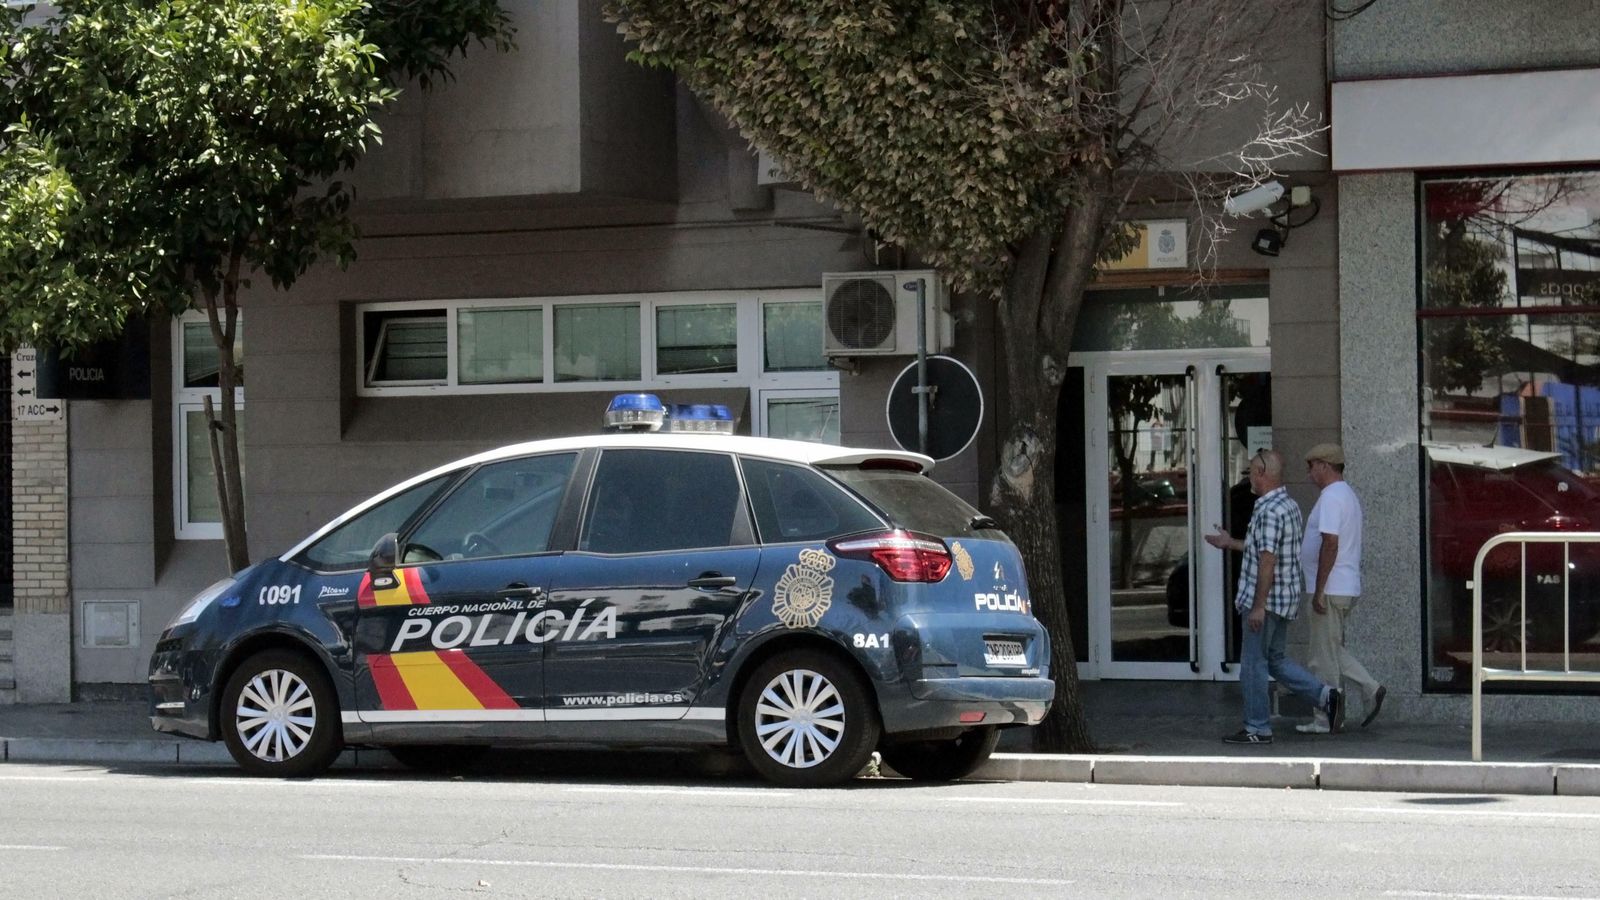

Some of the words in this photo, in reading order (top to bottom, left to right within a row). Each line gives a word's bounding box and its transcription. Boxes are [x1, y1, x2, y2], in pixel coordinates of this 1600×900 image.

[69, 367, 104, 380] POLICIA
[17, 405, 26, 416] 17
[27, 405, 45, 416] ACC
[267, 584, 302, 606] 091
[408, 605, 460, 617] CUERPO
[460, 601, 524, 613] NACIONAL
[527, 599, 547, 609] DE
[390, 598, 617, 652] POLICÍA
[853, 633, 890, 649] 8A1
[562, 693, 683, 706] www.policia.es
